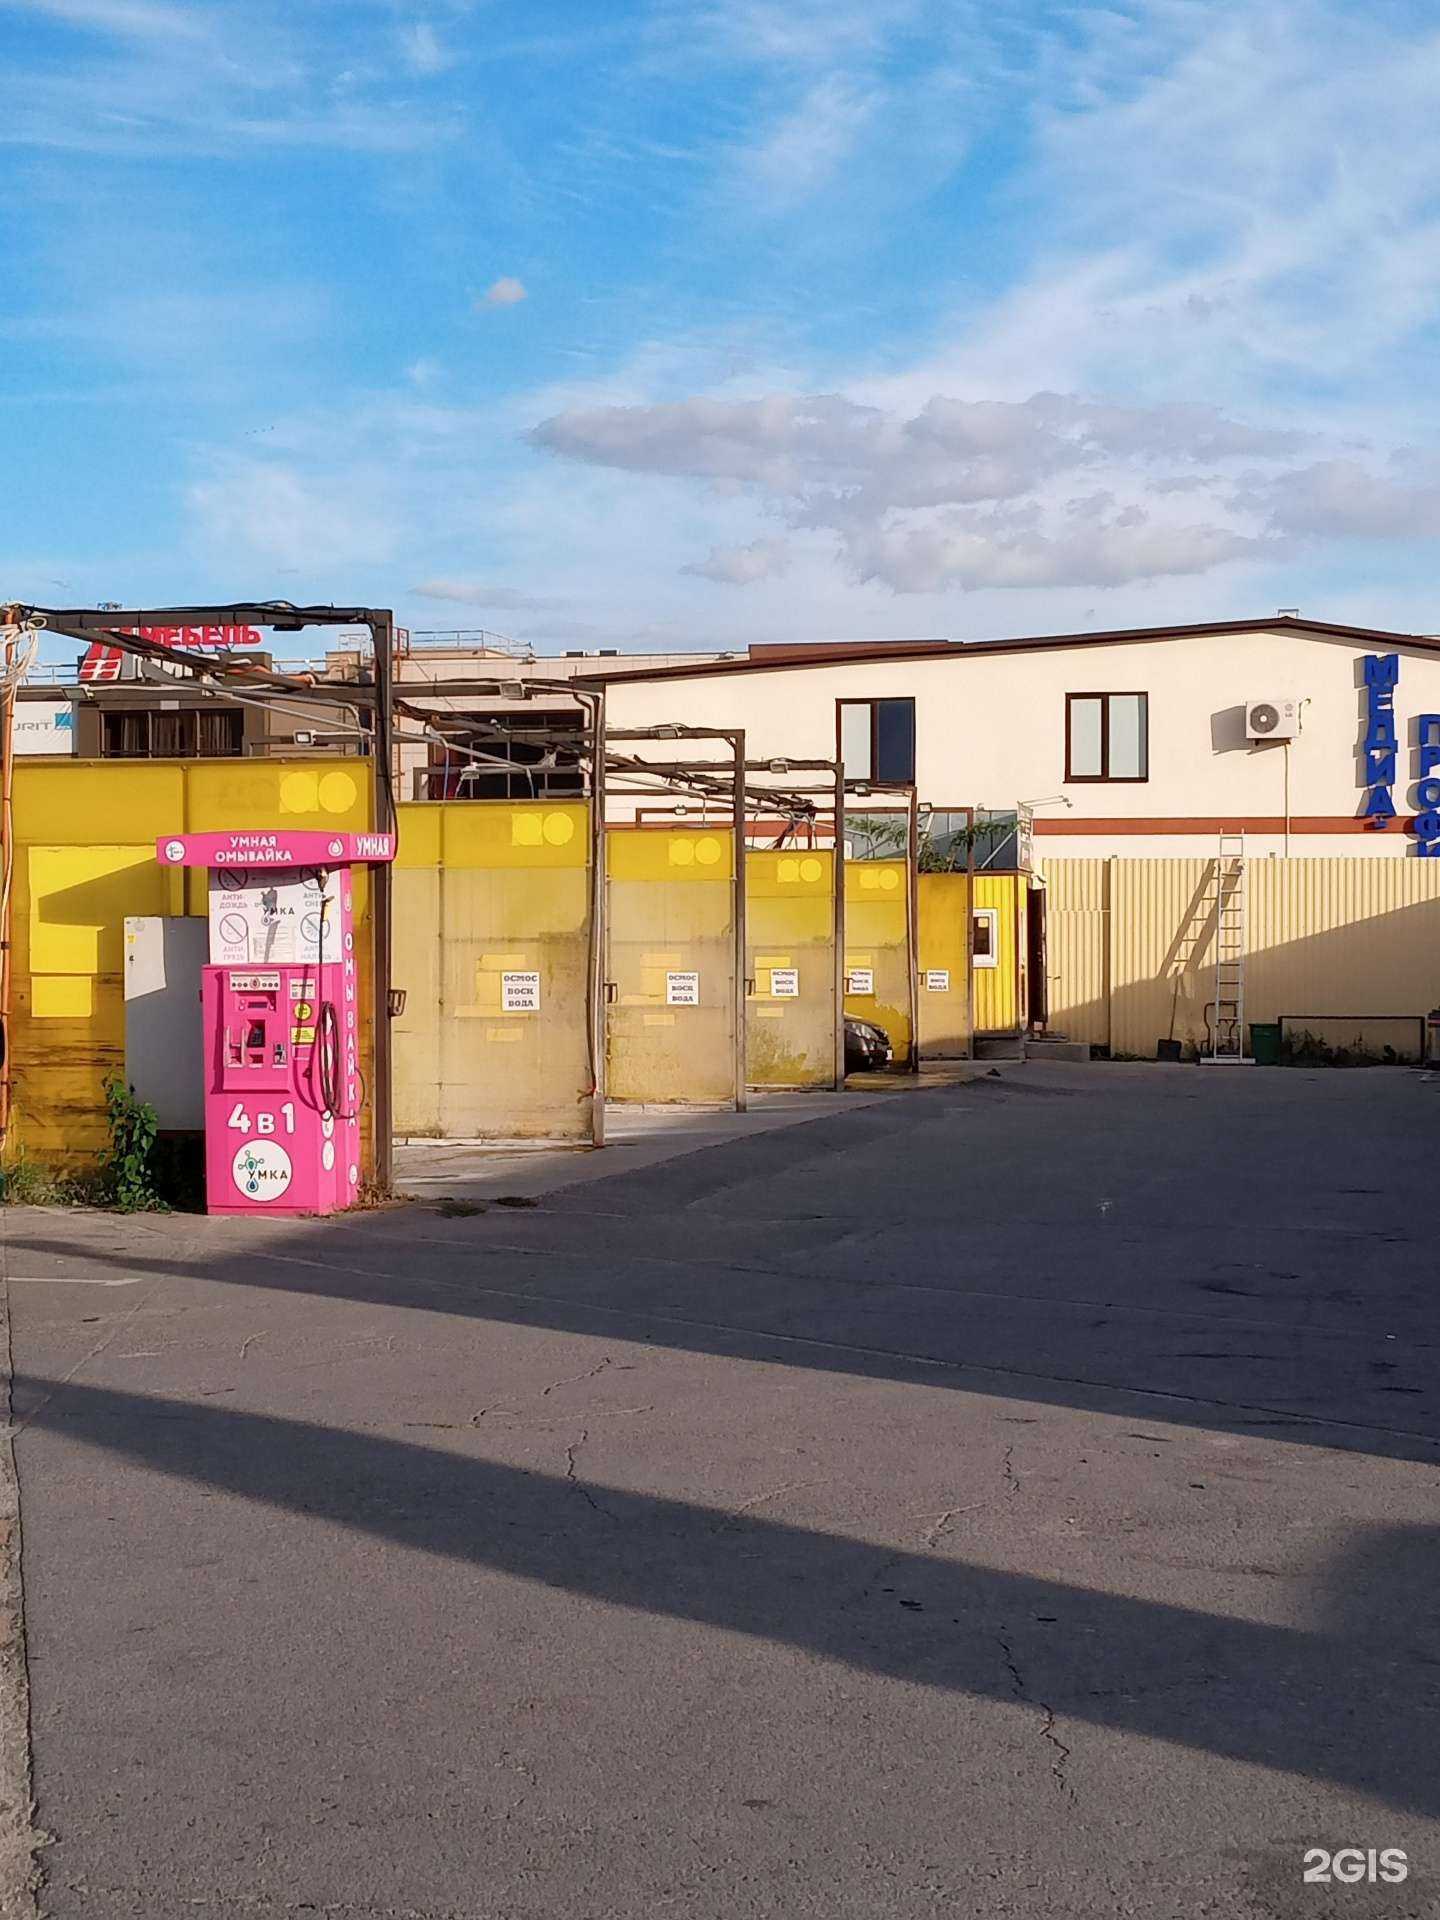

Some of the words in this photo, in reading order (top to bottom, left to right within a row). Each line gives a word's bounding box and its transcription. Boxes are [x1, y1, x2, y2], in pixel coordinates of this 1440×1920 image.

[139, 624, 262, 647] МЕБЕЛЬ
[230, 835, 277, 848] УМНАЯ
[356, 836, 390, 857] УМНАЯ
[215, 849, 292, 864] ОМЫВАЙКА
[503, 974, 538, 982] ОСМОС
[507, 987, 534, 995] ВОСК
[508, 999, 534, 1007] ВОДА
[248, 1170, 288, 1180] УМКА
